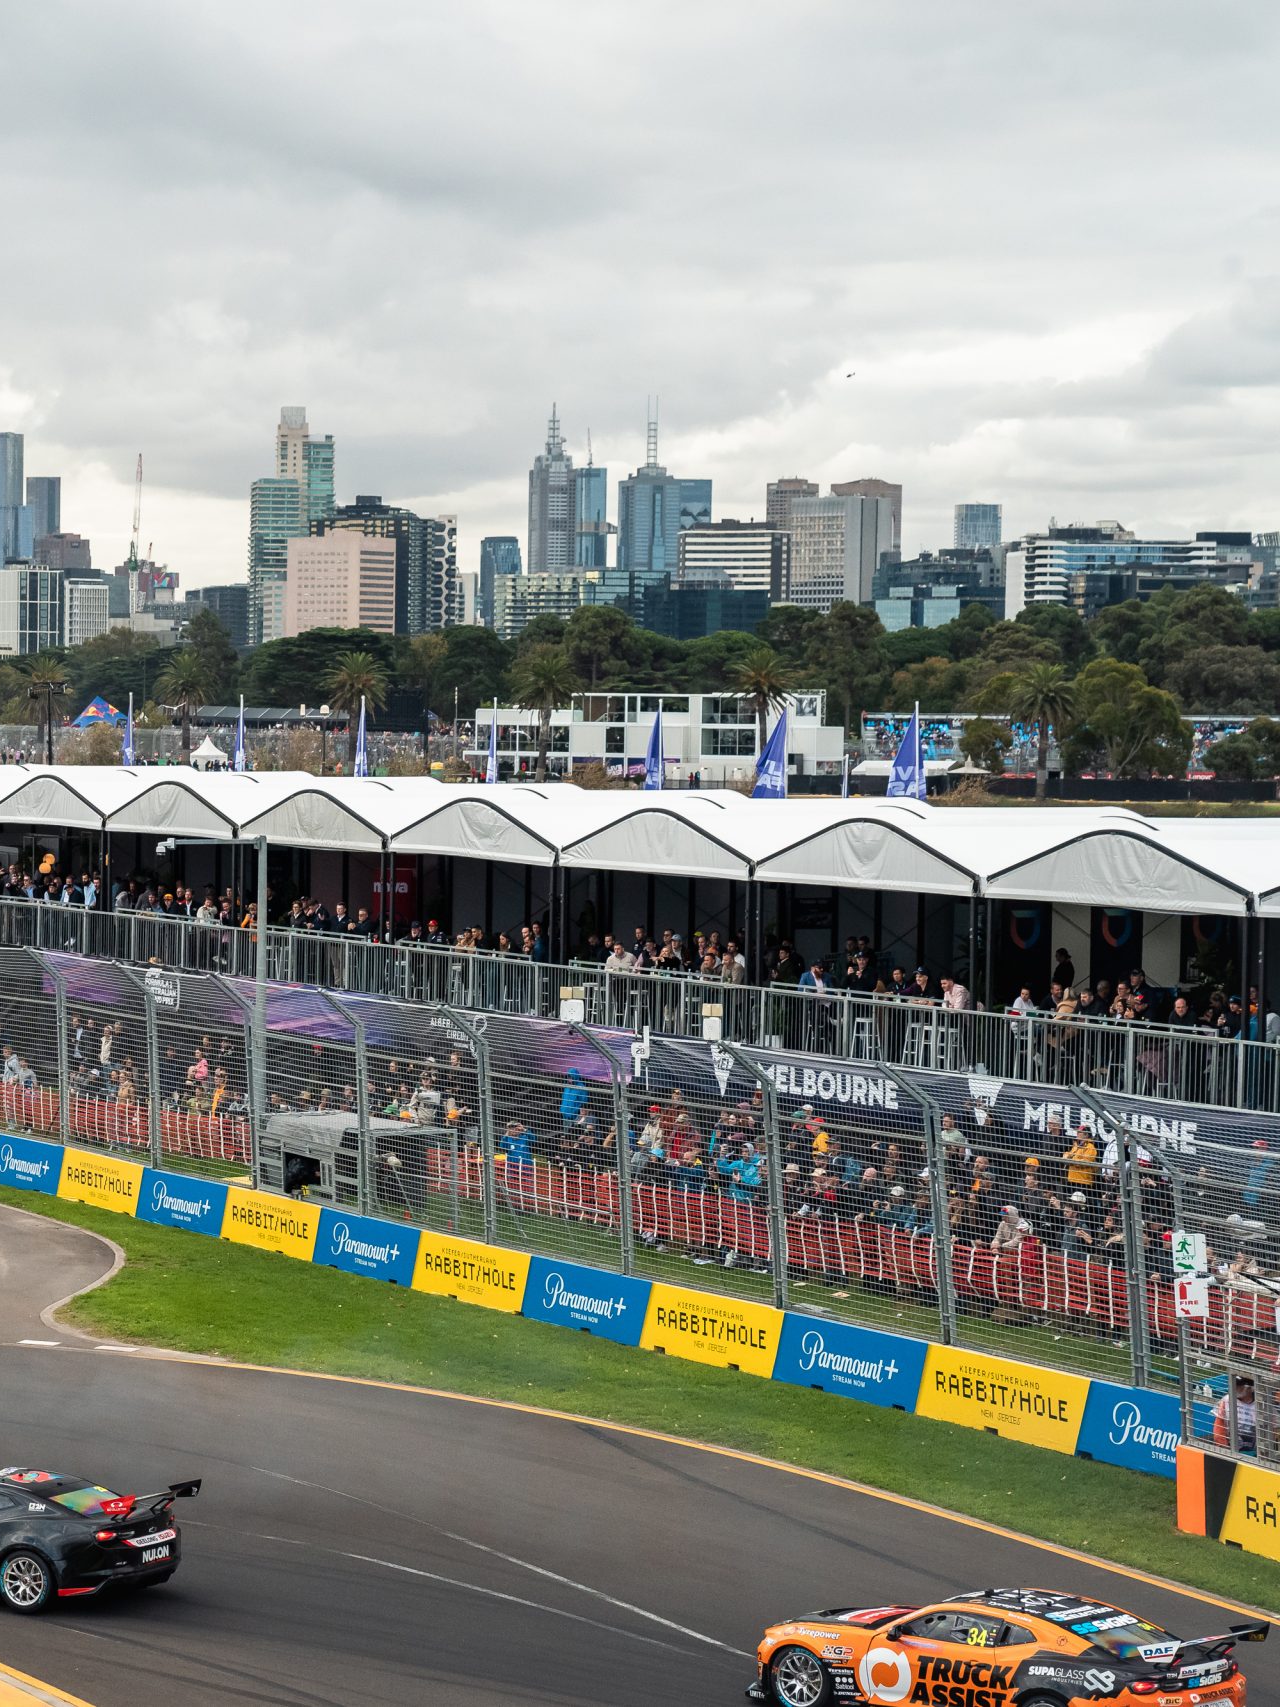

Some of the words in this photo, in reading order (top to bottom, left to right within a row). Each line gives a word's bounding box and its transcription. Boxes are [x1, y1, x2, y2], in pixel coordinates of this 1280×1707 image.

[0, 1143, 50, 1179] Paramount+
[66, 1166, 133, 1198] RABBIT/HOLE
[151, 1180, 211, 1219] Paramount+
[232, 1205, 309, 1240] RABBIT/HOLE
[331, 1222, 400, 1265] Paramount+
[424, 1252, 516, 1292] RABBIT/HOLE
[542, 1271, 627, 1320] Paramount+
[570, 1311, 587, 1321] STREAM
[587, 1316, 598, 1324] NOW
[677, 1301, 744, 1322] KIEFER/SUTHERLAND
[656, 1305, 767, 1351] RABBIT/HOLE
[798, 1330, 899, 1384] Paramount+
[832, 1374, 852, 1385] STREAM
[853, 1379, 866, 1388] NOW
[959, 1364, 1040, 1390] KIEFER/SUTHERLAND
[935, 1369, 1069, 1424] RABBIT/HOLE
[1151, 1450, 1176, 1464] STREAM
[142, 1545, 170, 1564] NULON
[798, 1627, 841, 1640] Tyrepower
[967, 1627, 987, 1647] 34
[833, 1646, 854, 1655] GP
[1143, 1646, 1174, 1657] DAF
[917, 1655, 1013, 1690] TRUCK
[1028, 1665, 1085, 1680] SUPAGLASS
[1051, 1677, 1083, 1686] INDUSTRIES
[910, 1682, 1007, 1707] ASSIST
[1199, 1691, 1218, 1701] TRUCK
